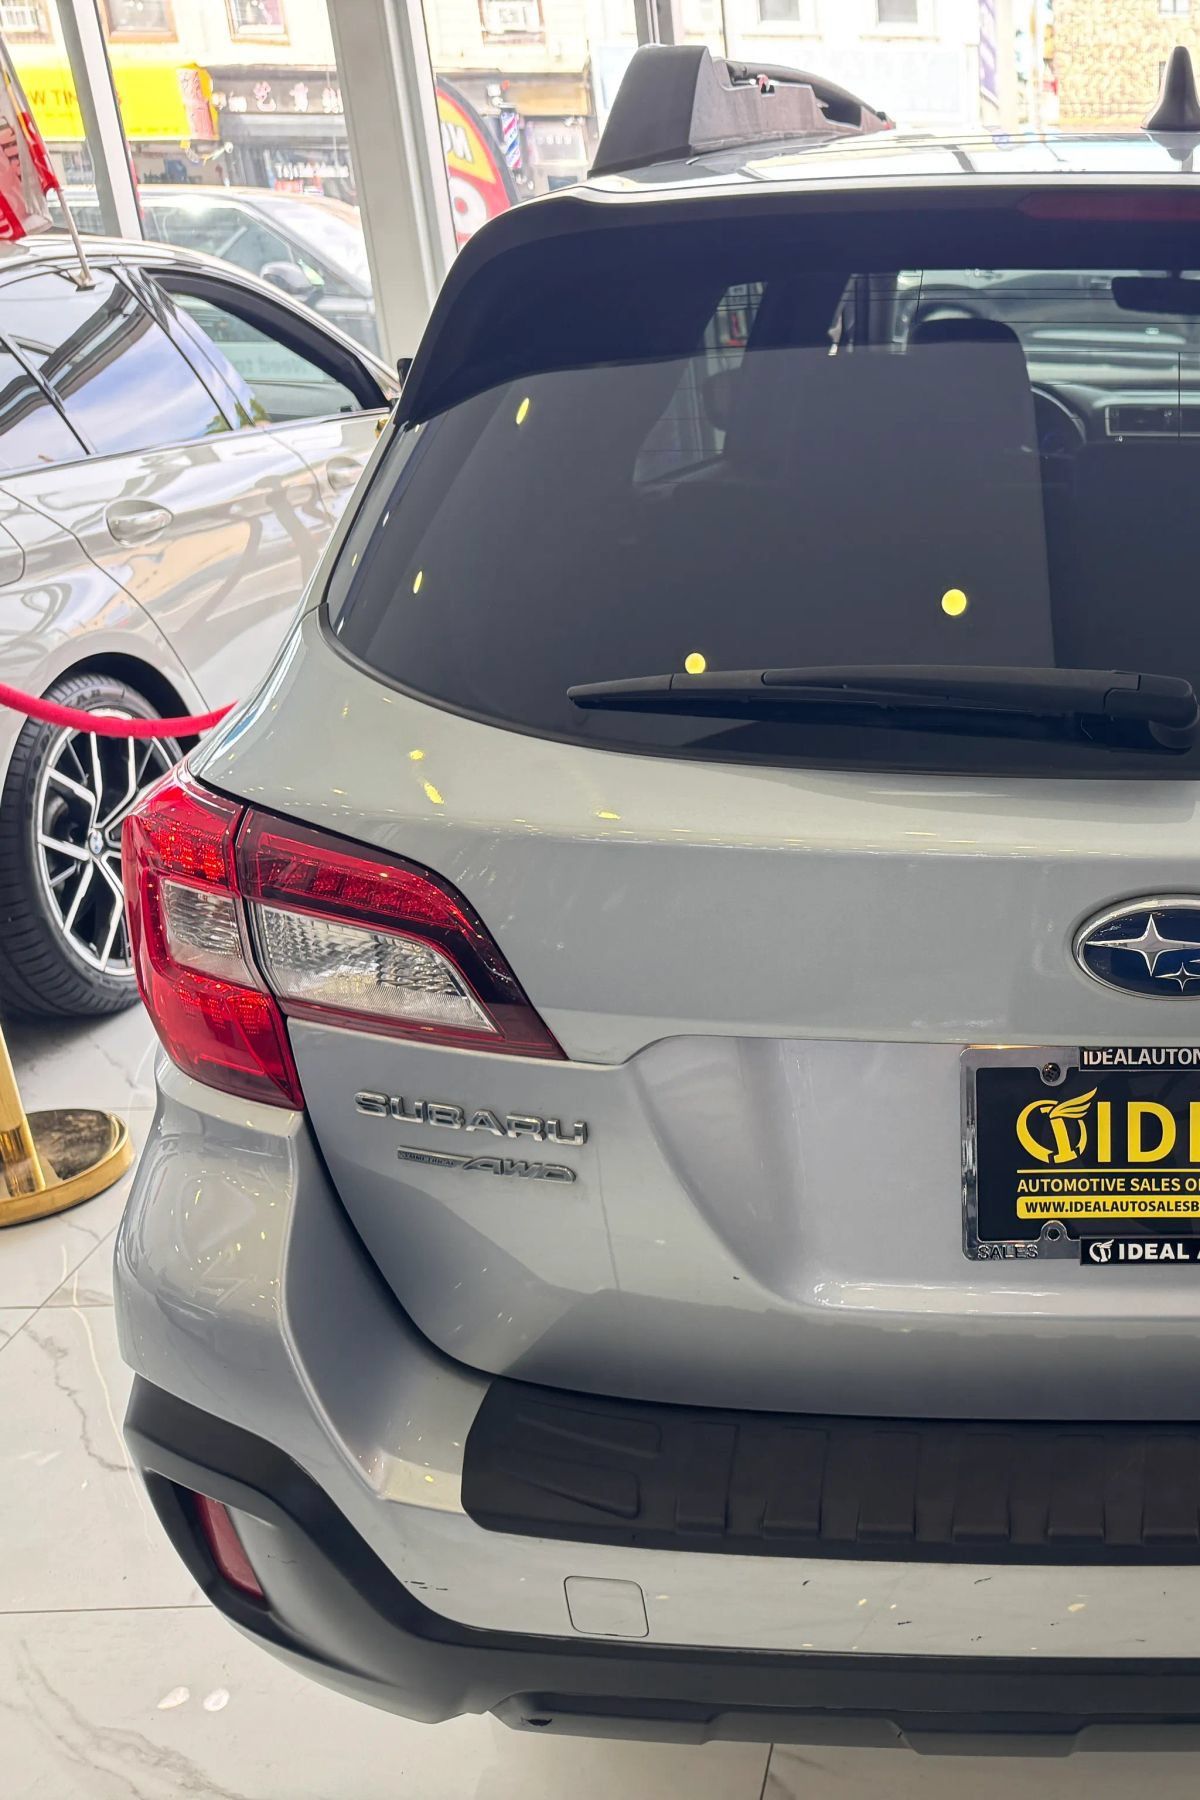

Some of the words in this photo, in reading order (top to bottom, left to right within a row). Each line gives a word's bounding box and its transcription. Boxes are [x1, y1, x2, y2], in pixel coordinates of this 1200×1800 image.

[354, 1089, 588, 1146] SUBARU
[463, 1157, 577, 1184] AWD
[1017, 1178, 1126, 1193] AUTOMOTIVE
[1130, 1178, 1183, 1193] SALES
[977, 1243, 1038, 1259] SALES
[1118, 1243, 1190, 1260] IDEAL
